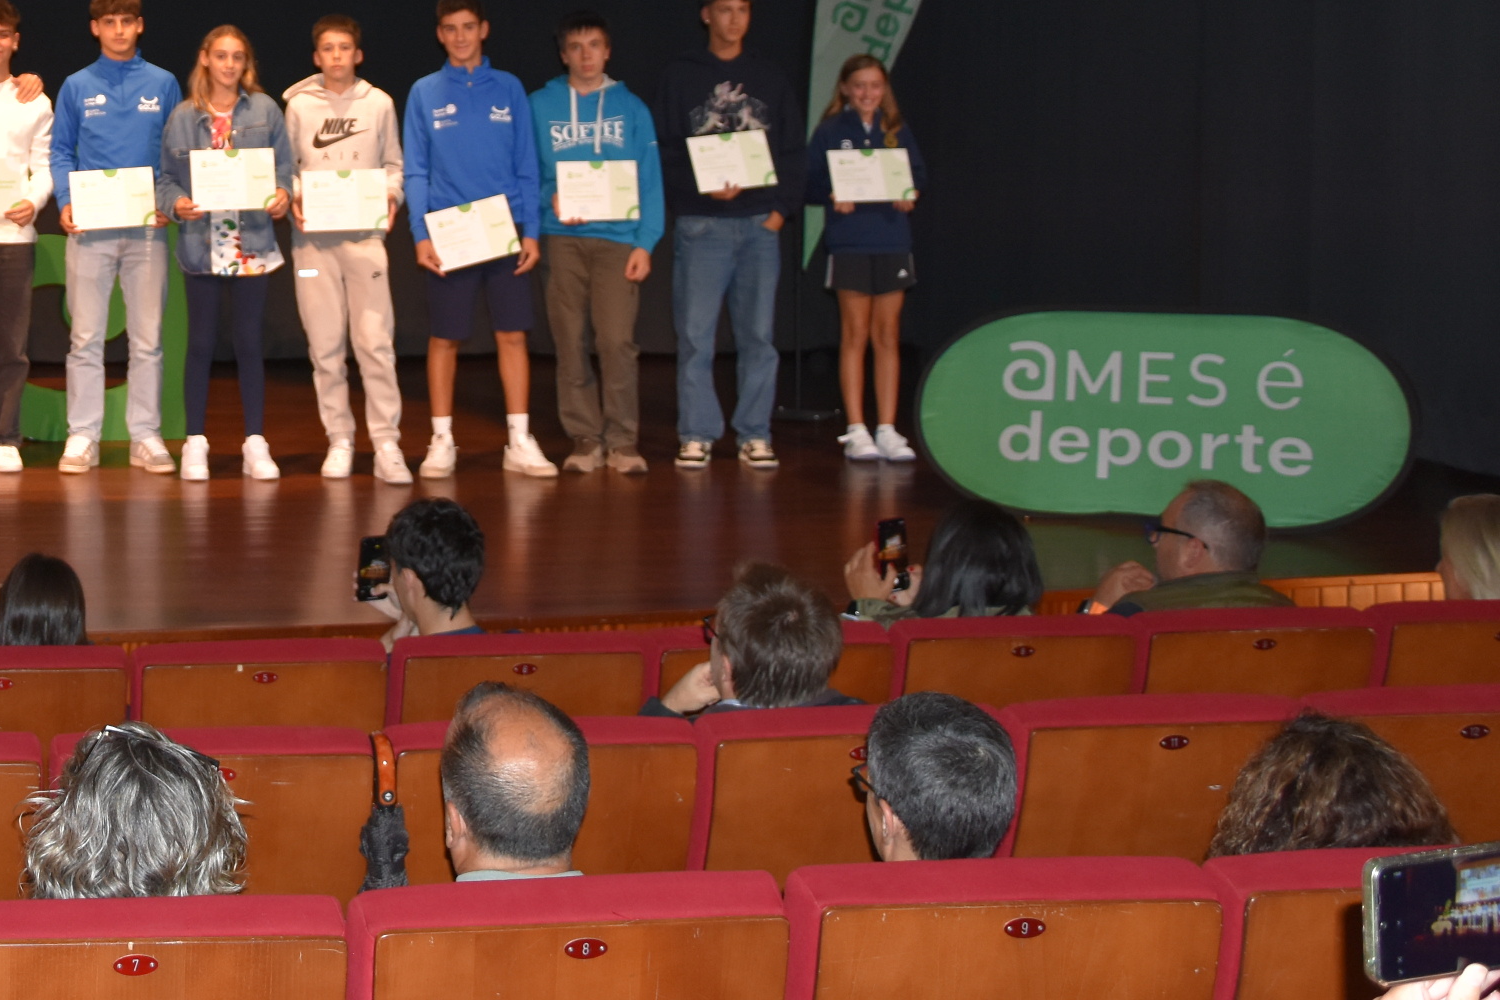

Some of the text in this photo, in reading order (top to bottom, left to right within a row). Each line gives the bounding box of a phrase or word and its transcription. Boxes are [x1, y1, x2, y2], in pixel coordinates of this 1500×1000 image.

[320, 117, 357, 135] NIKE
[1256, 348, 1304, 410] é
[998, 410, 1314, 479] deporte
[1021, 922, 1029, 935] 9
[582, 942, 590, 955] 8
[132, 958, 140, 971] 7
